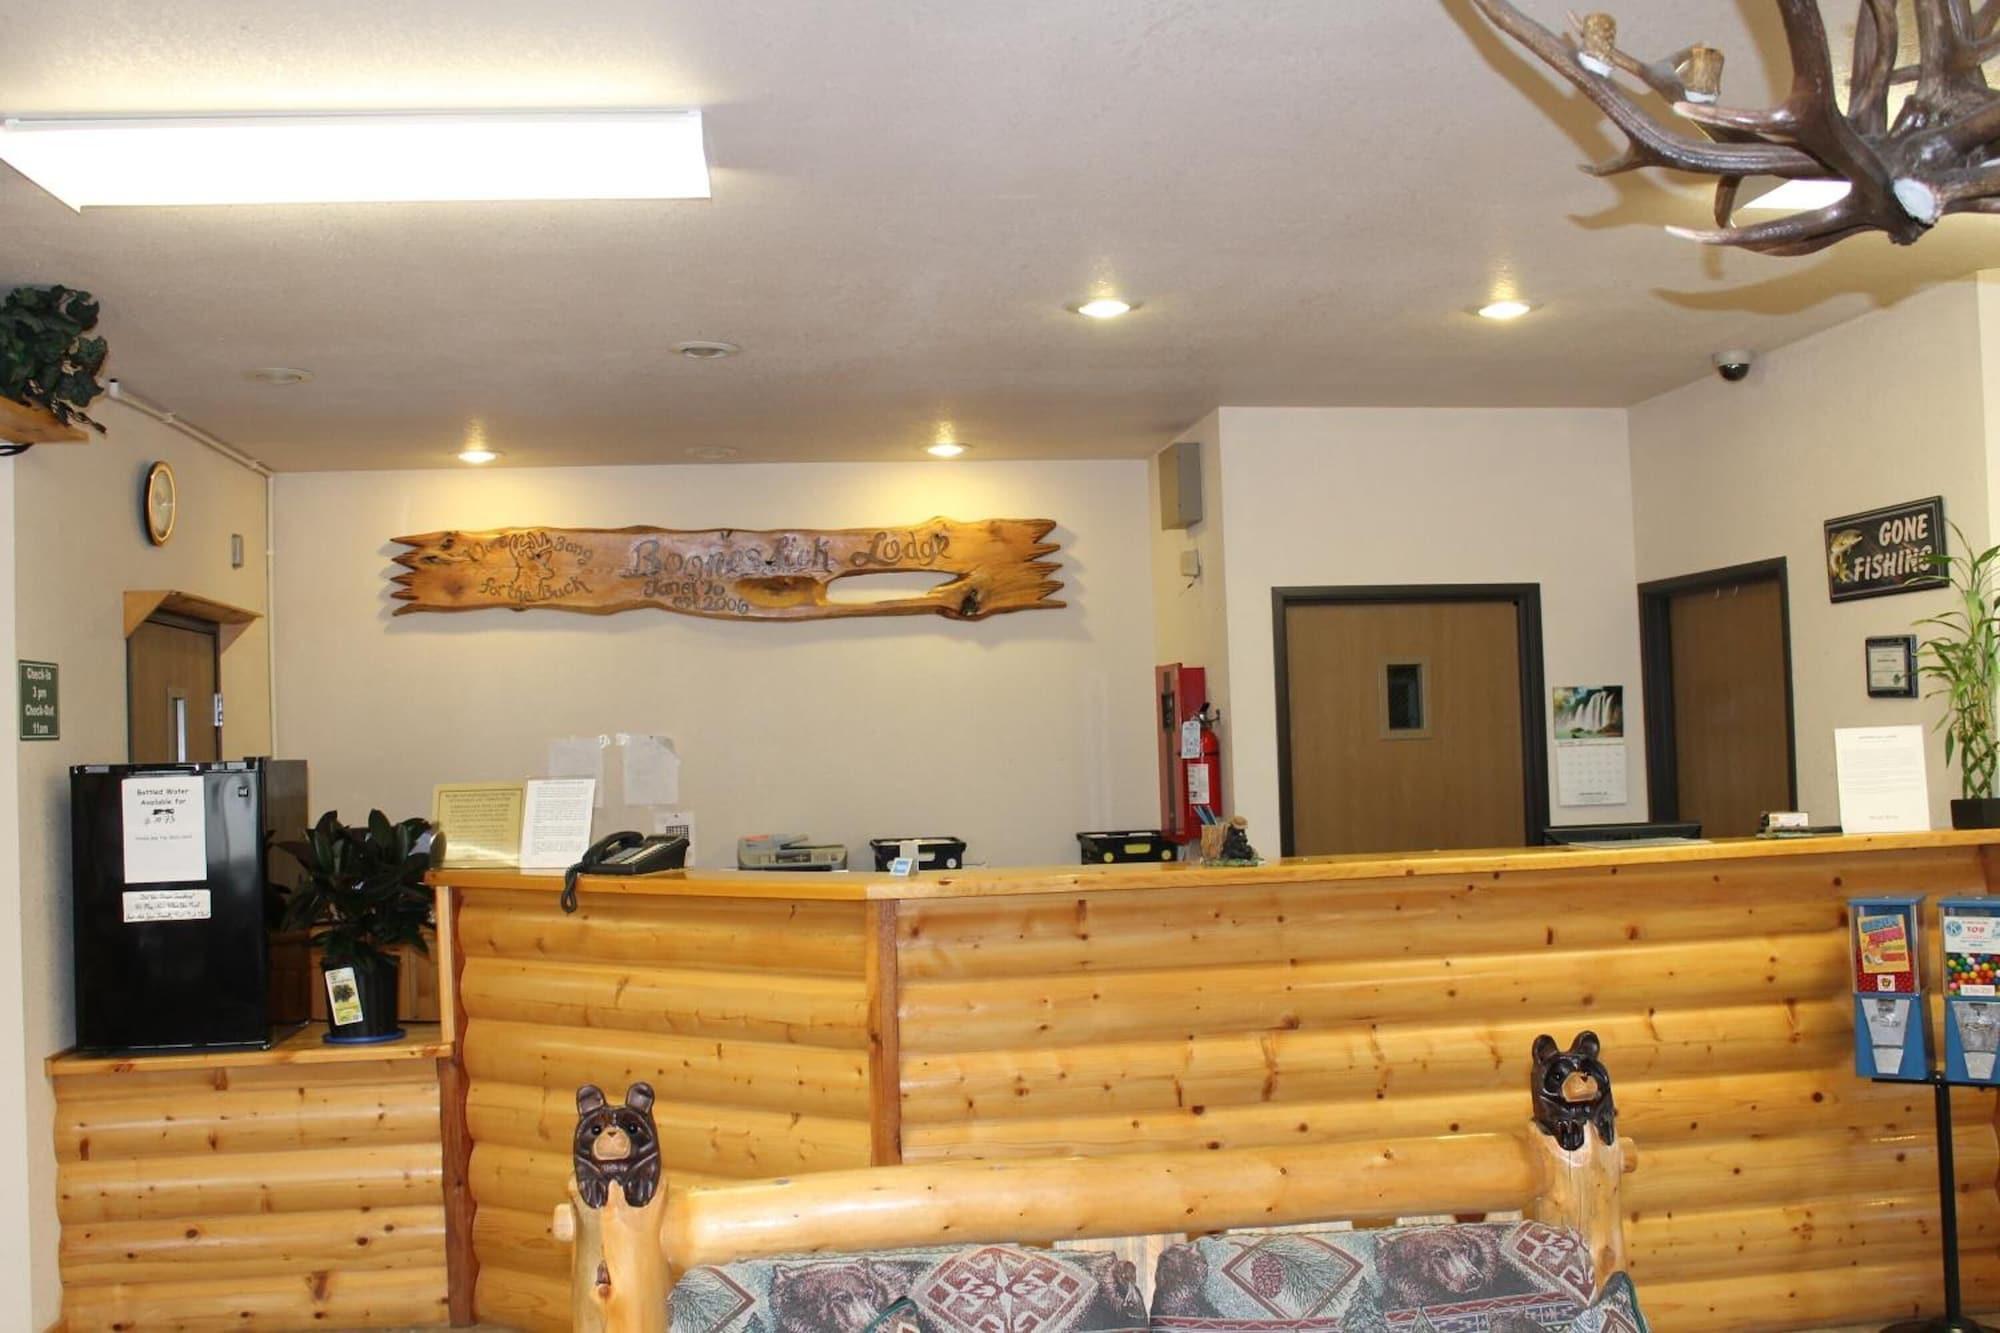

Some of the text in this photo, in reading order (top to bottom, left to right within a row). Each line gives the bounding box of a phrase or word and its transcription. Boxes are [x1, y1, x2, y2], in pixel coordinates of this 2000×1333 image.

[849, 523, 952, 567] Lodge
[1878, 513, 1929, 547] GONE
[1853, 544, 1932, 582] FISHING
